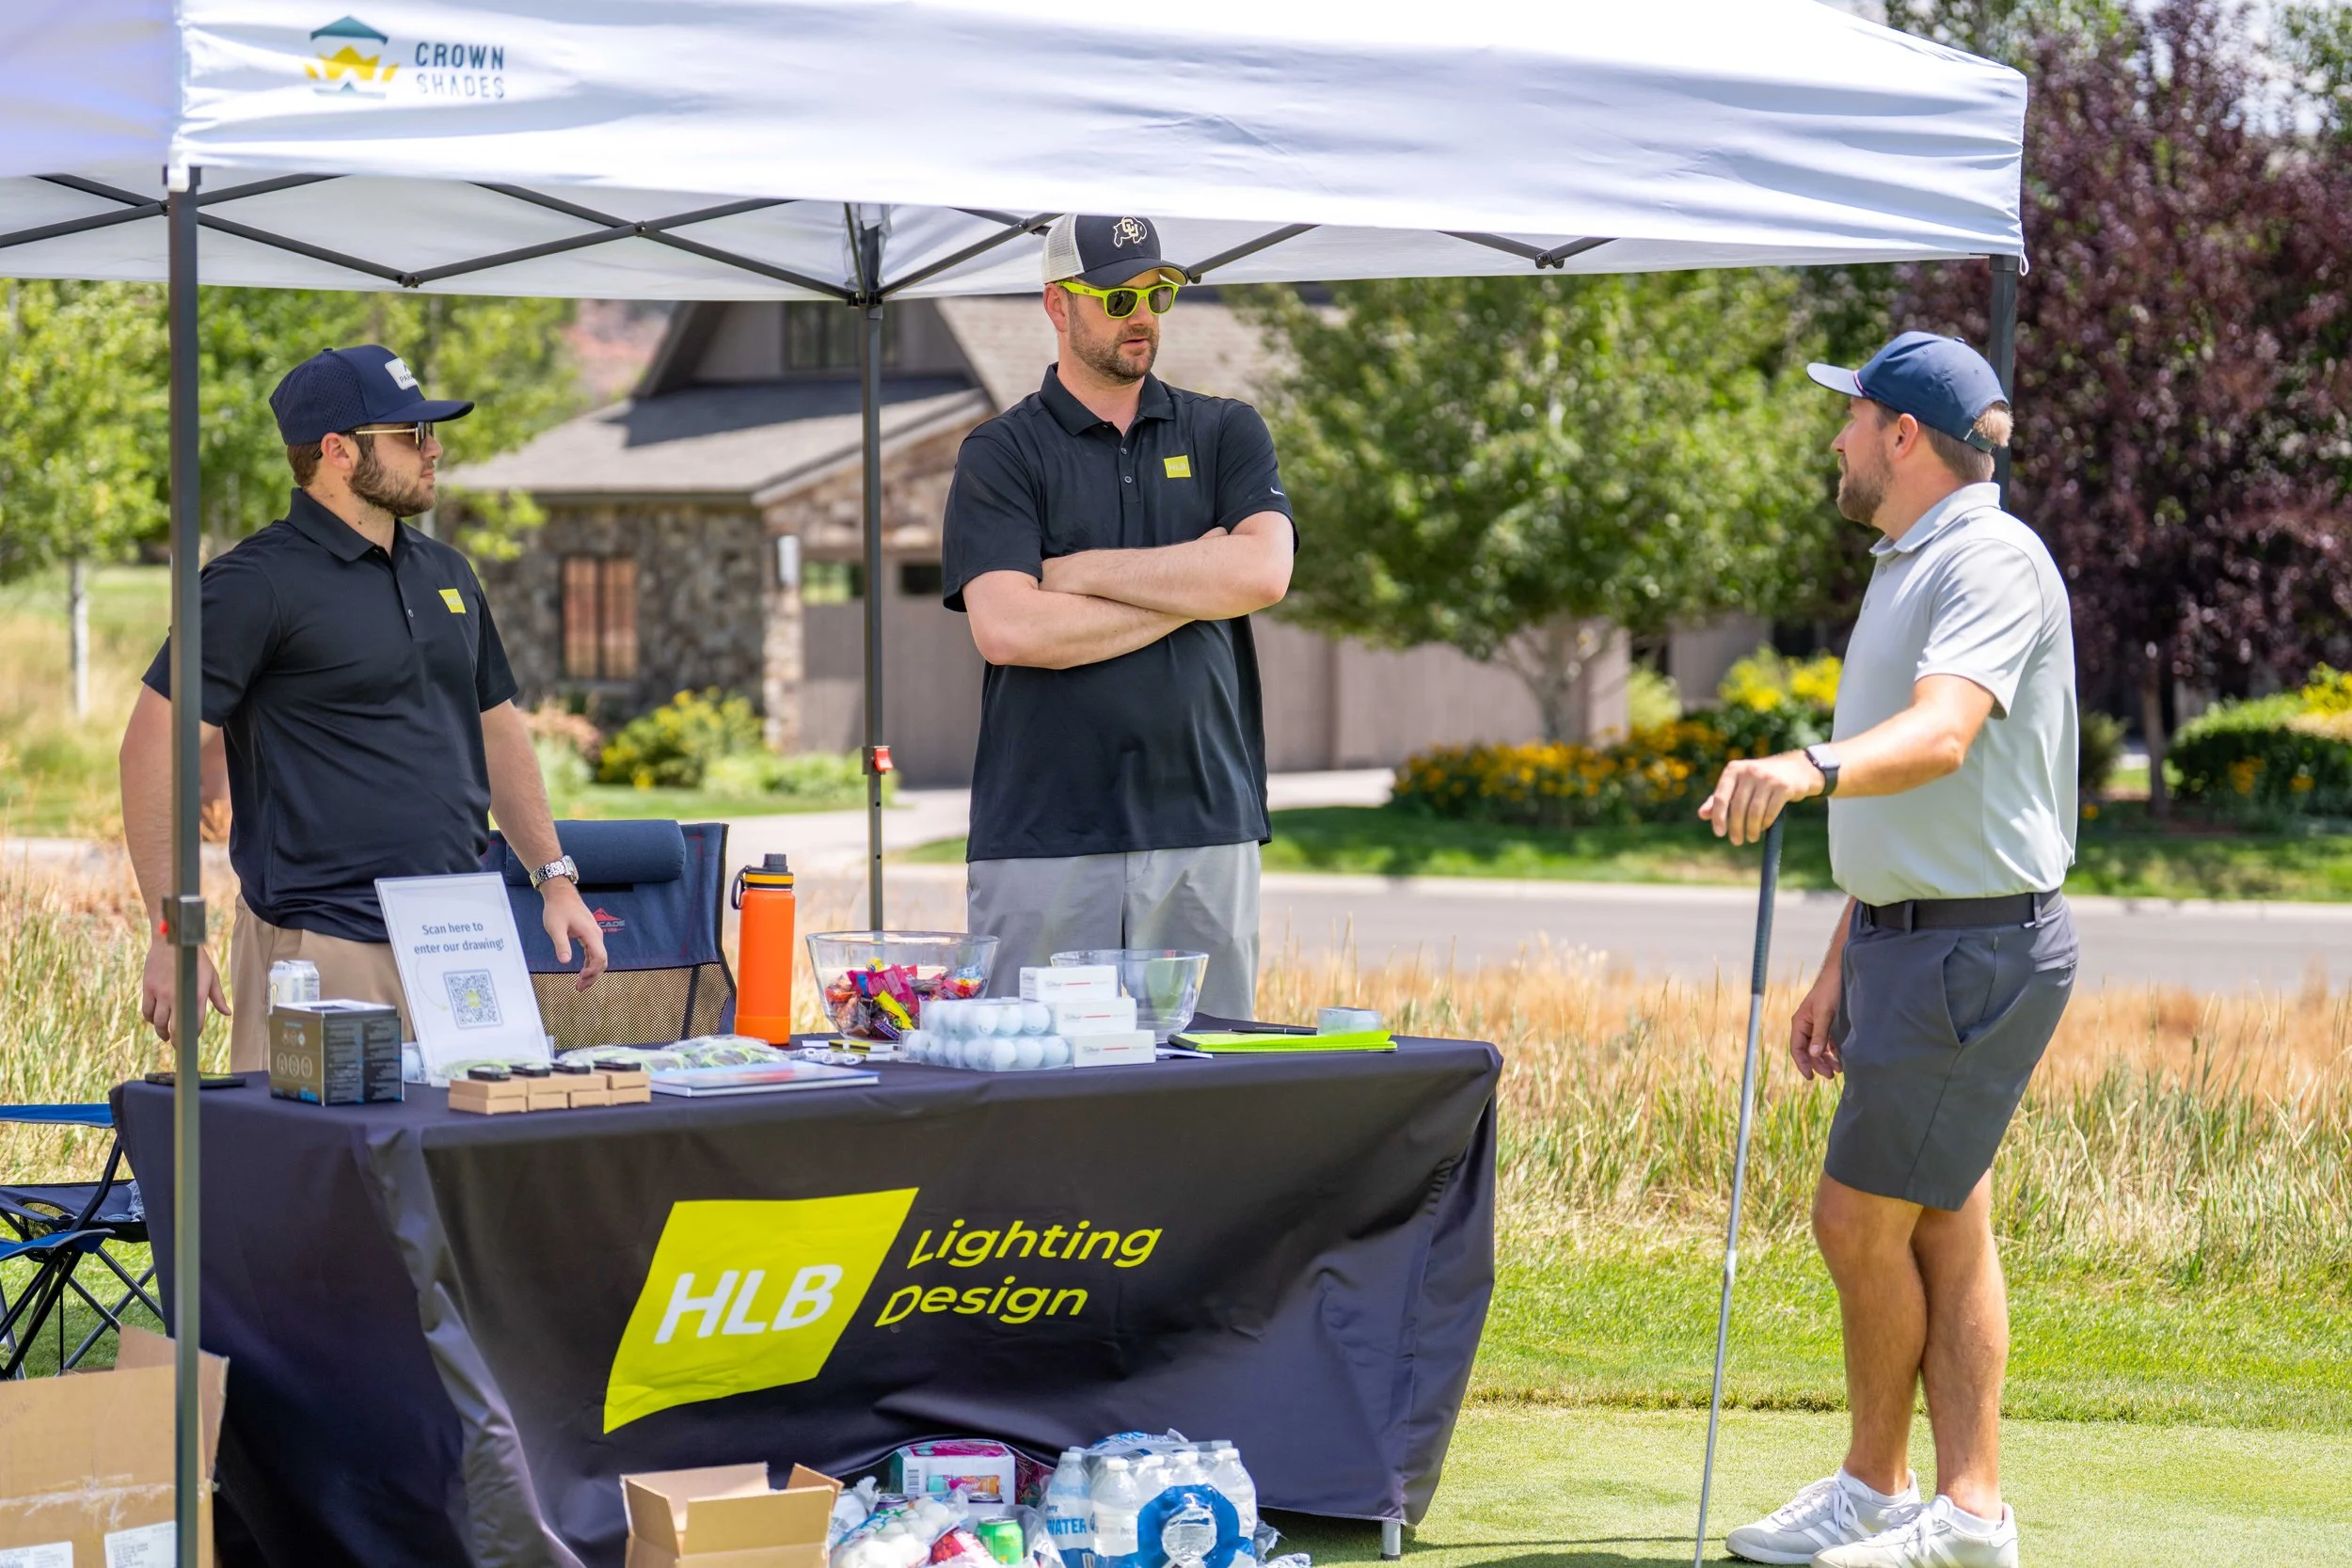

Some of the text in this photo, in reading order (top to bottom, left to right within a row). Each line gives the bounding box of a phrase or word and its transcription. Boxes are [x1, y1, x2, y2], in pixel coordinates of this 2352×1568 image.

[414, 41, 504, 71] CROWN
[416, 73, 505, 99] SHADES
[421, 922, 484, 936] Scan here to
[414, 937, 505, 955] enter our drawing!
[906, 1218, 1163, 1269] Lighting
[653, 1264, 843, 1344] HLB
[874, 1275, 1089, 1327] Design
[1046, 1517, 1088, 1536] WATER
